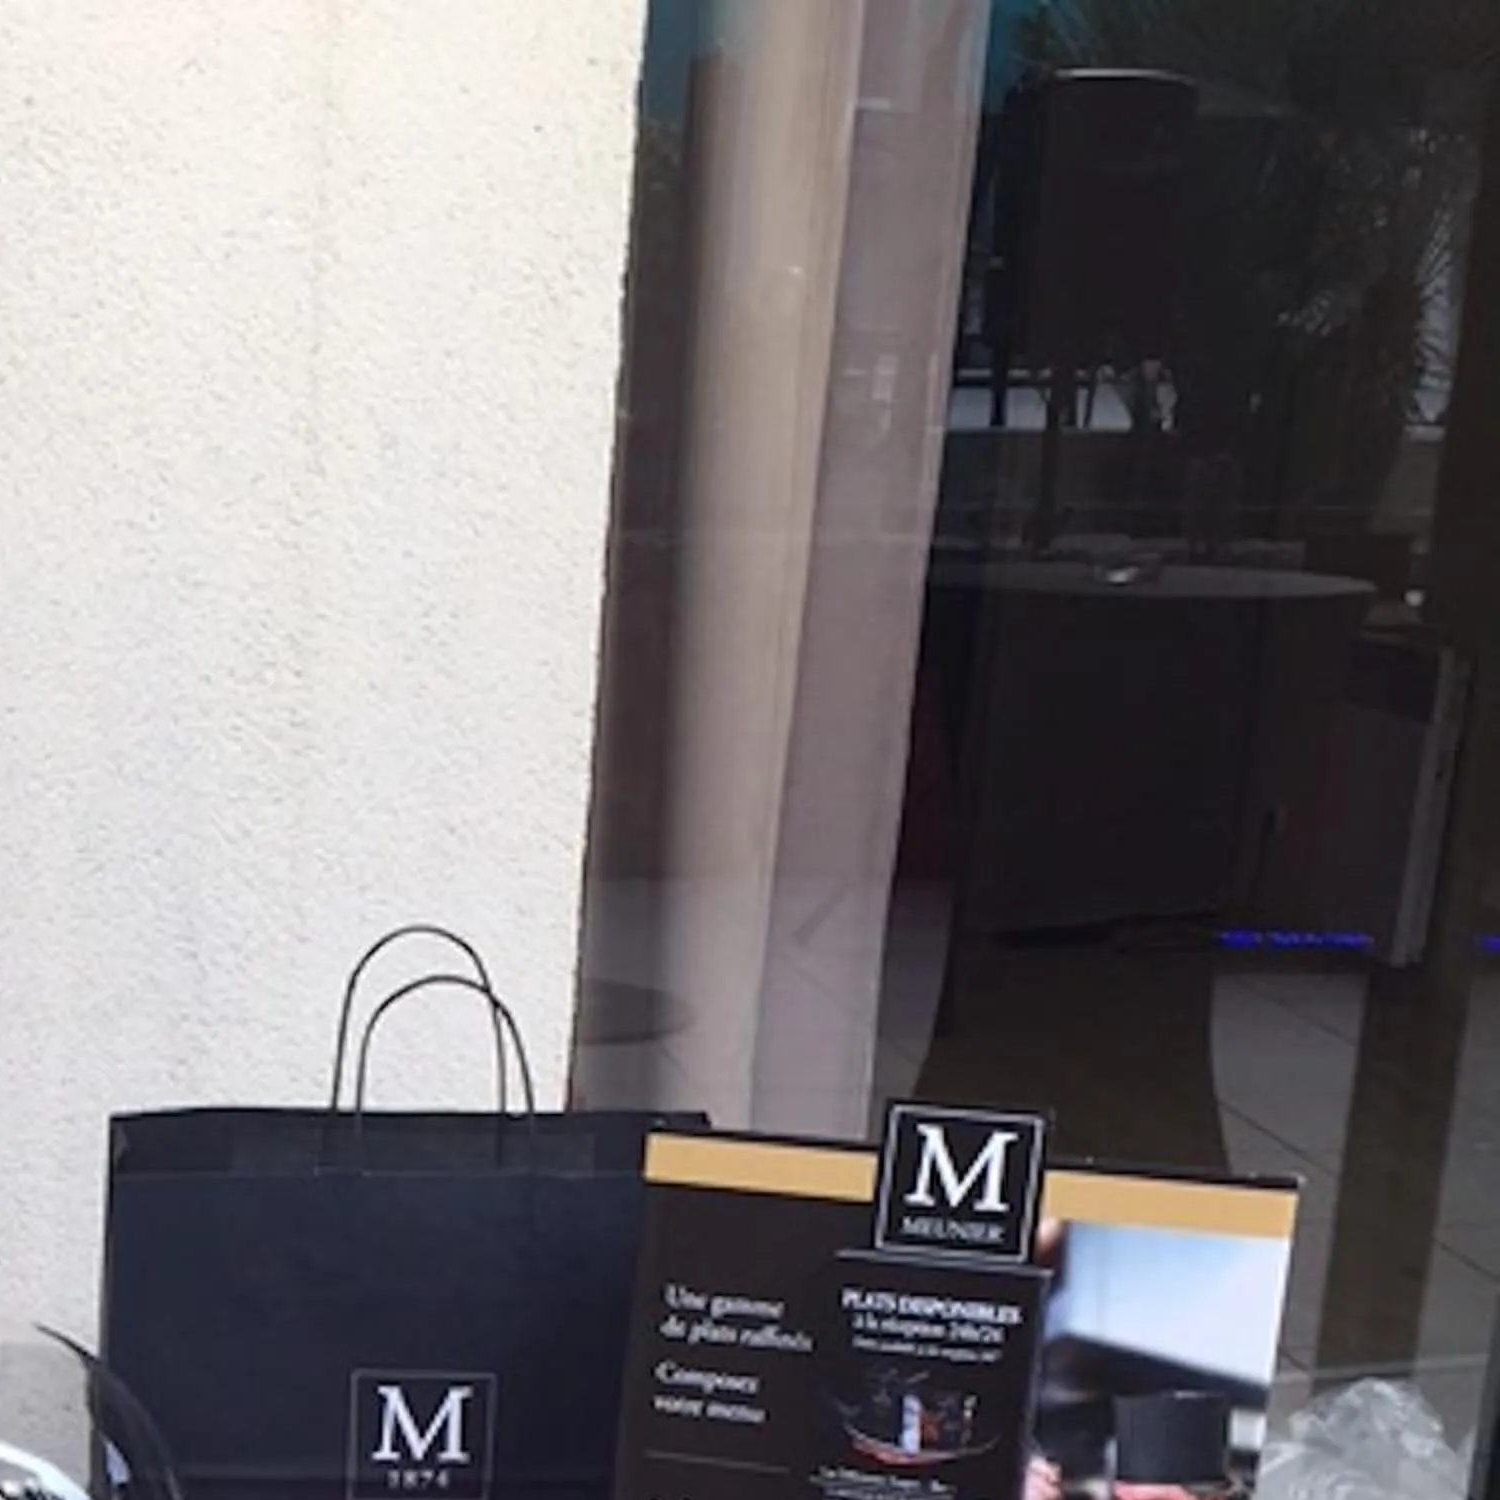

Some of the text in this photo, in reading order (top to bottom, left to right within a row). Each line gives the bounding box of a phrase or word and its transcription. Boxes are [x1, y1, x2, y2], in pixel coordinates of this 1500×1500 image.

[904, 1124, 1018, 1211] M
[664, 1283, 784, 1319] Une gamme
[842, 1288, 1022, 1325] PLATS DISPONIBLES
[659, 1314, 813, 1352] de plats raffinés
[372, 1385, 473, 1464] M
[706, 1402, 766, 1423] menu
